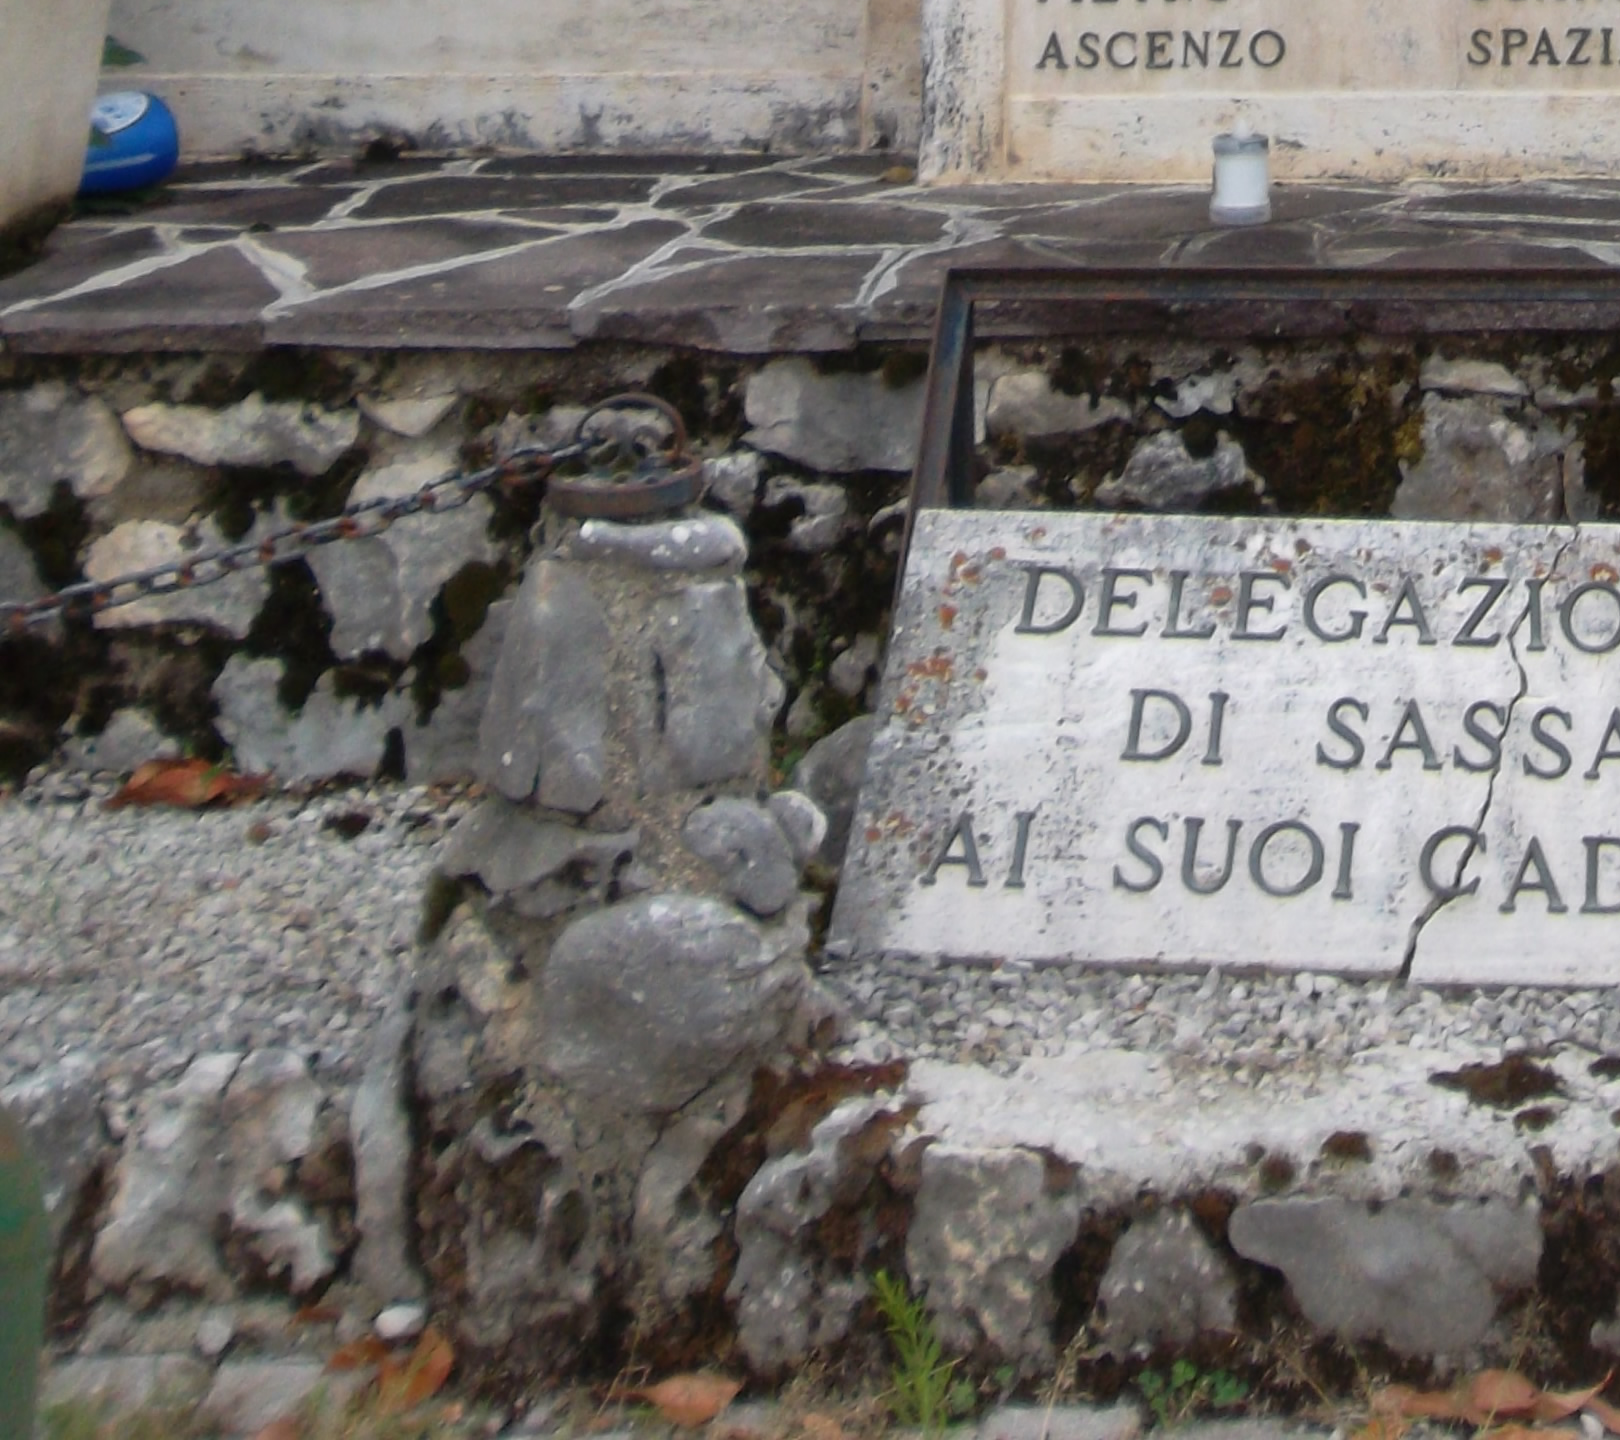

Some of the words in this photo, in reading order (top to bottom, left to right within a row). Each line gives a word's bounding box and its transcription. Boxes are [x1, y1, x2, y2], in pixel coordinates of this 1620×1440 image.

[1036, 30, 1286, 71] ASCENZO
[1119, 688, 1231, 765] DI
[922, 811, 1037, 889] AI
[1112, 816, 1361, 900] SUOI
